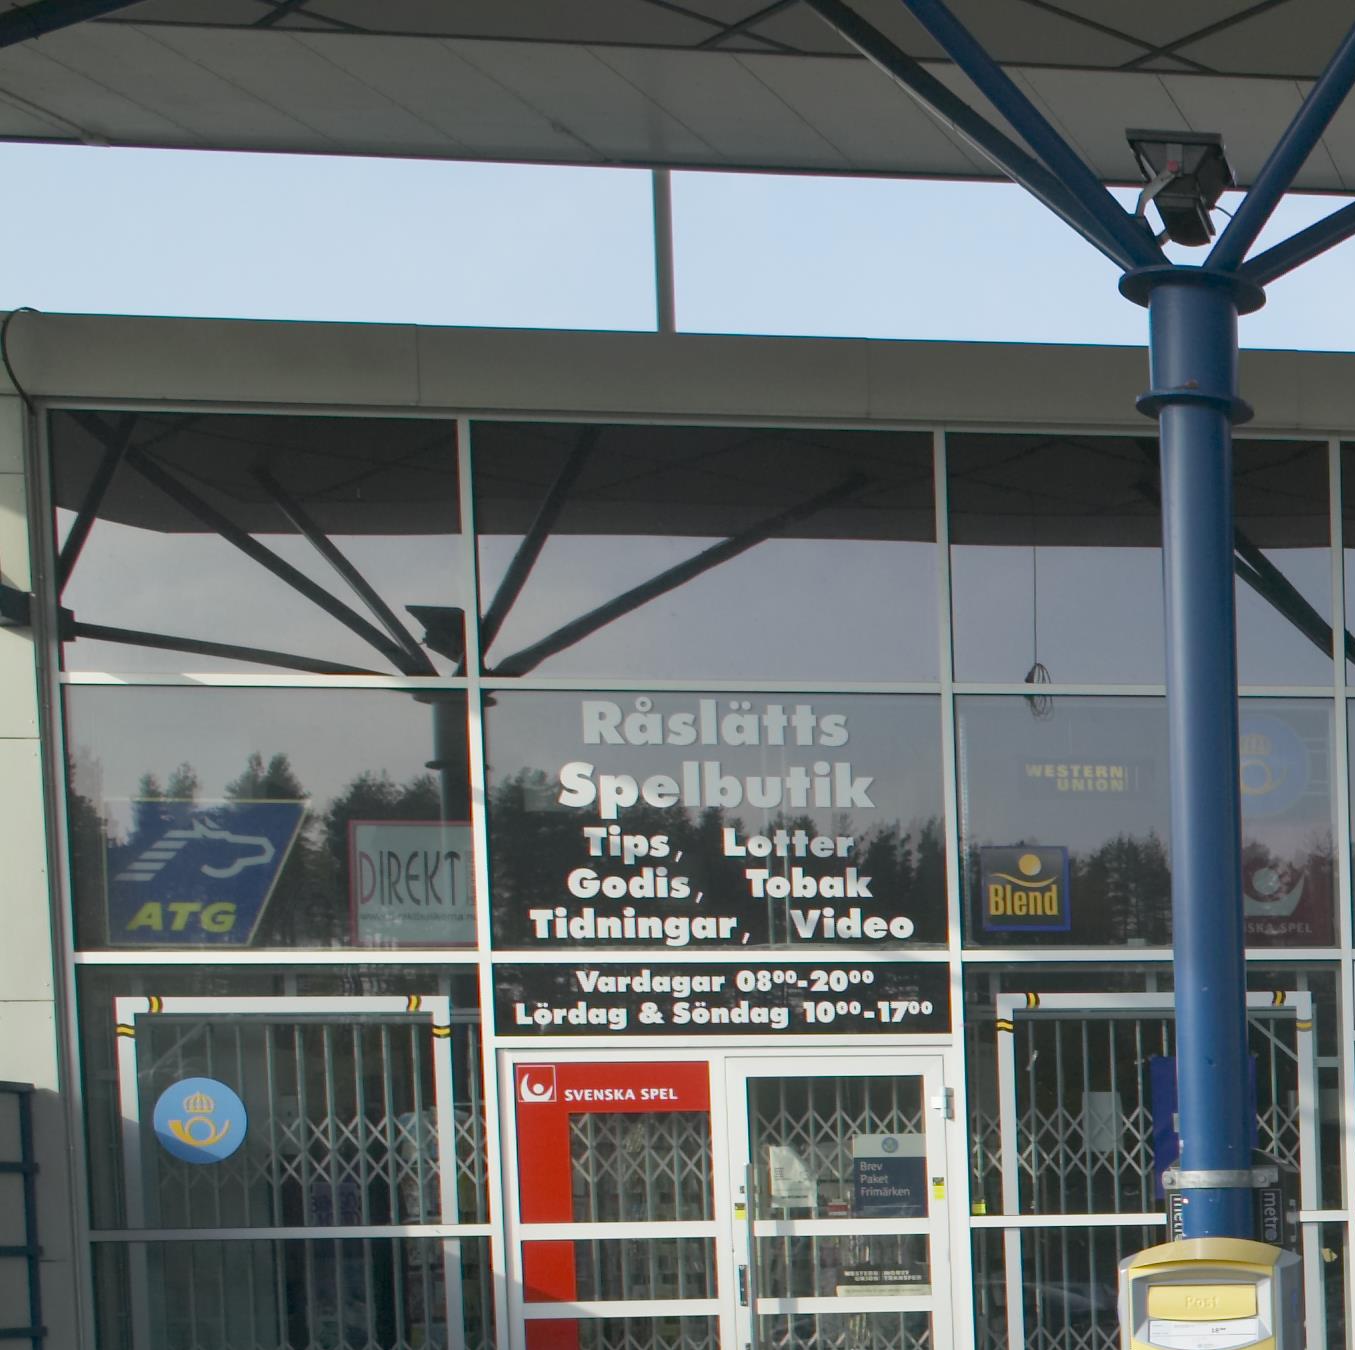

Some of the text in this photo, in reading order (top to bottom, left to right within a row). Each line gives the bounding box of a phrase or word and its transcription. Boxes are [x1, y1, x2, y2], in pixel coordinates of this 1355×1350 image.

[582, 696, 850, 747] Råslätts
[1025, 764, 1123, 778] WESTERN
[1057, 778, 1123, 792] UNION
[557, 762, 876, 819] Spelbutik
[584, 827, 854, 864] Tips, Lotter
[567, 867, 873, 904] Godis, Tobak
[988, 884, 1058, 916] Blend
[127, 902, 237, 933] ATG
[530, 908, 914, 947] Tidningar, Video
[577, 970, 725, 998] Vardagar
[515, 1002, 628, 1030] Lördag
[638, 1003, 665, 1025] &
[672, 1002, 789, 1030] Söndag
[564, 1087, 678, 1102] SVENSKA SPEL
[860, 1162, 882, 1171] Brev
[860, 1174, 888, 1184] Paket
[860, 1186, 911, 1197] Frimärken
